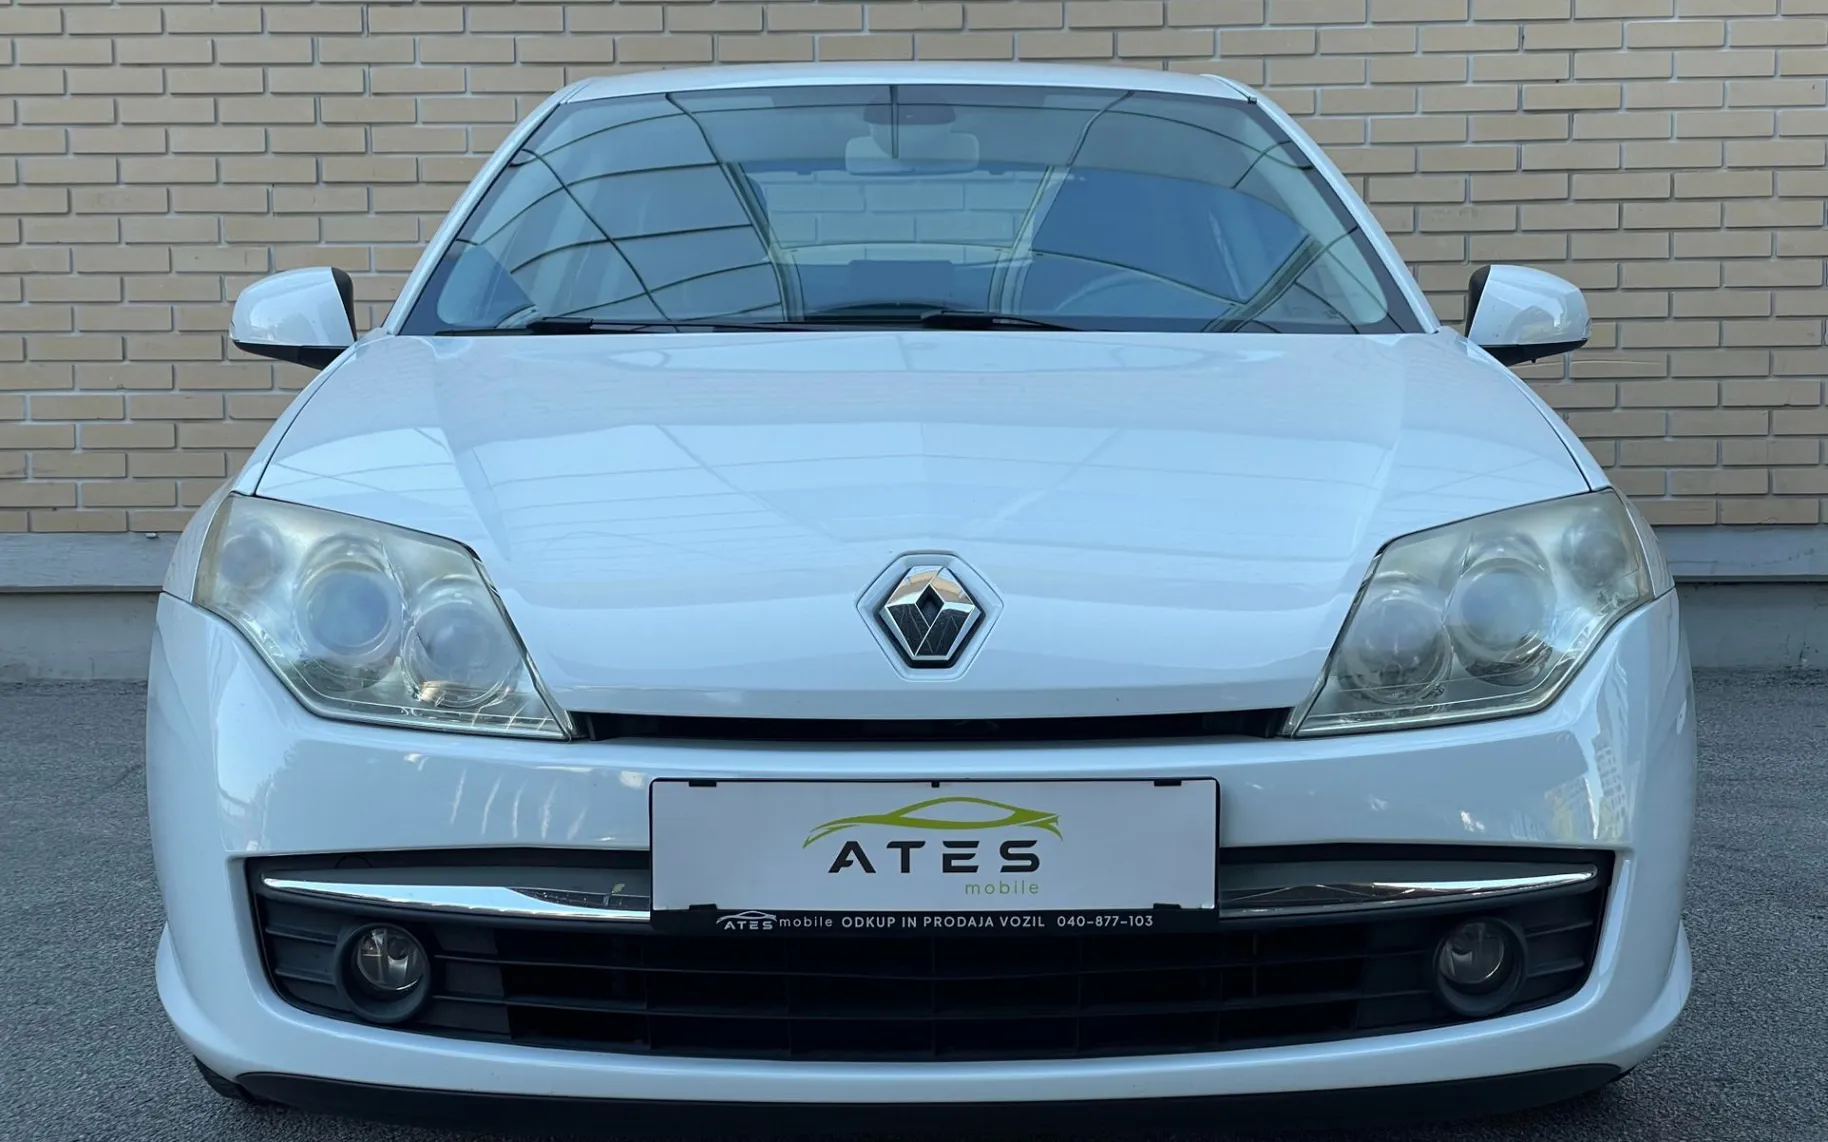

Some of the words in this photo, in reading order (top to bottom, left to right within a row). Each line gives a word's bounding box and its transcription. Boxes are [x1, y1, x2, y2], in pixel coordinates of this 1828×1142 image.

[828, 840, 1041, 874] ATES
[965, 880, 1040, 895] mobile
[724, 919, 774, 930] ATES
[779, 915, 834, 928] mobile
[841, 917, 896, 928] ODKUP
[902, 917, 917, 928] IN
[923, 916, 994, 929] PRODAJA
[1000, 916, 1045, 928] VOZIL
[1057, 915, 1154, 928] 040-877-103
